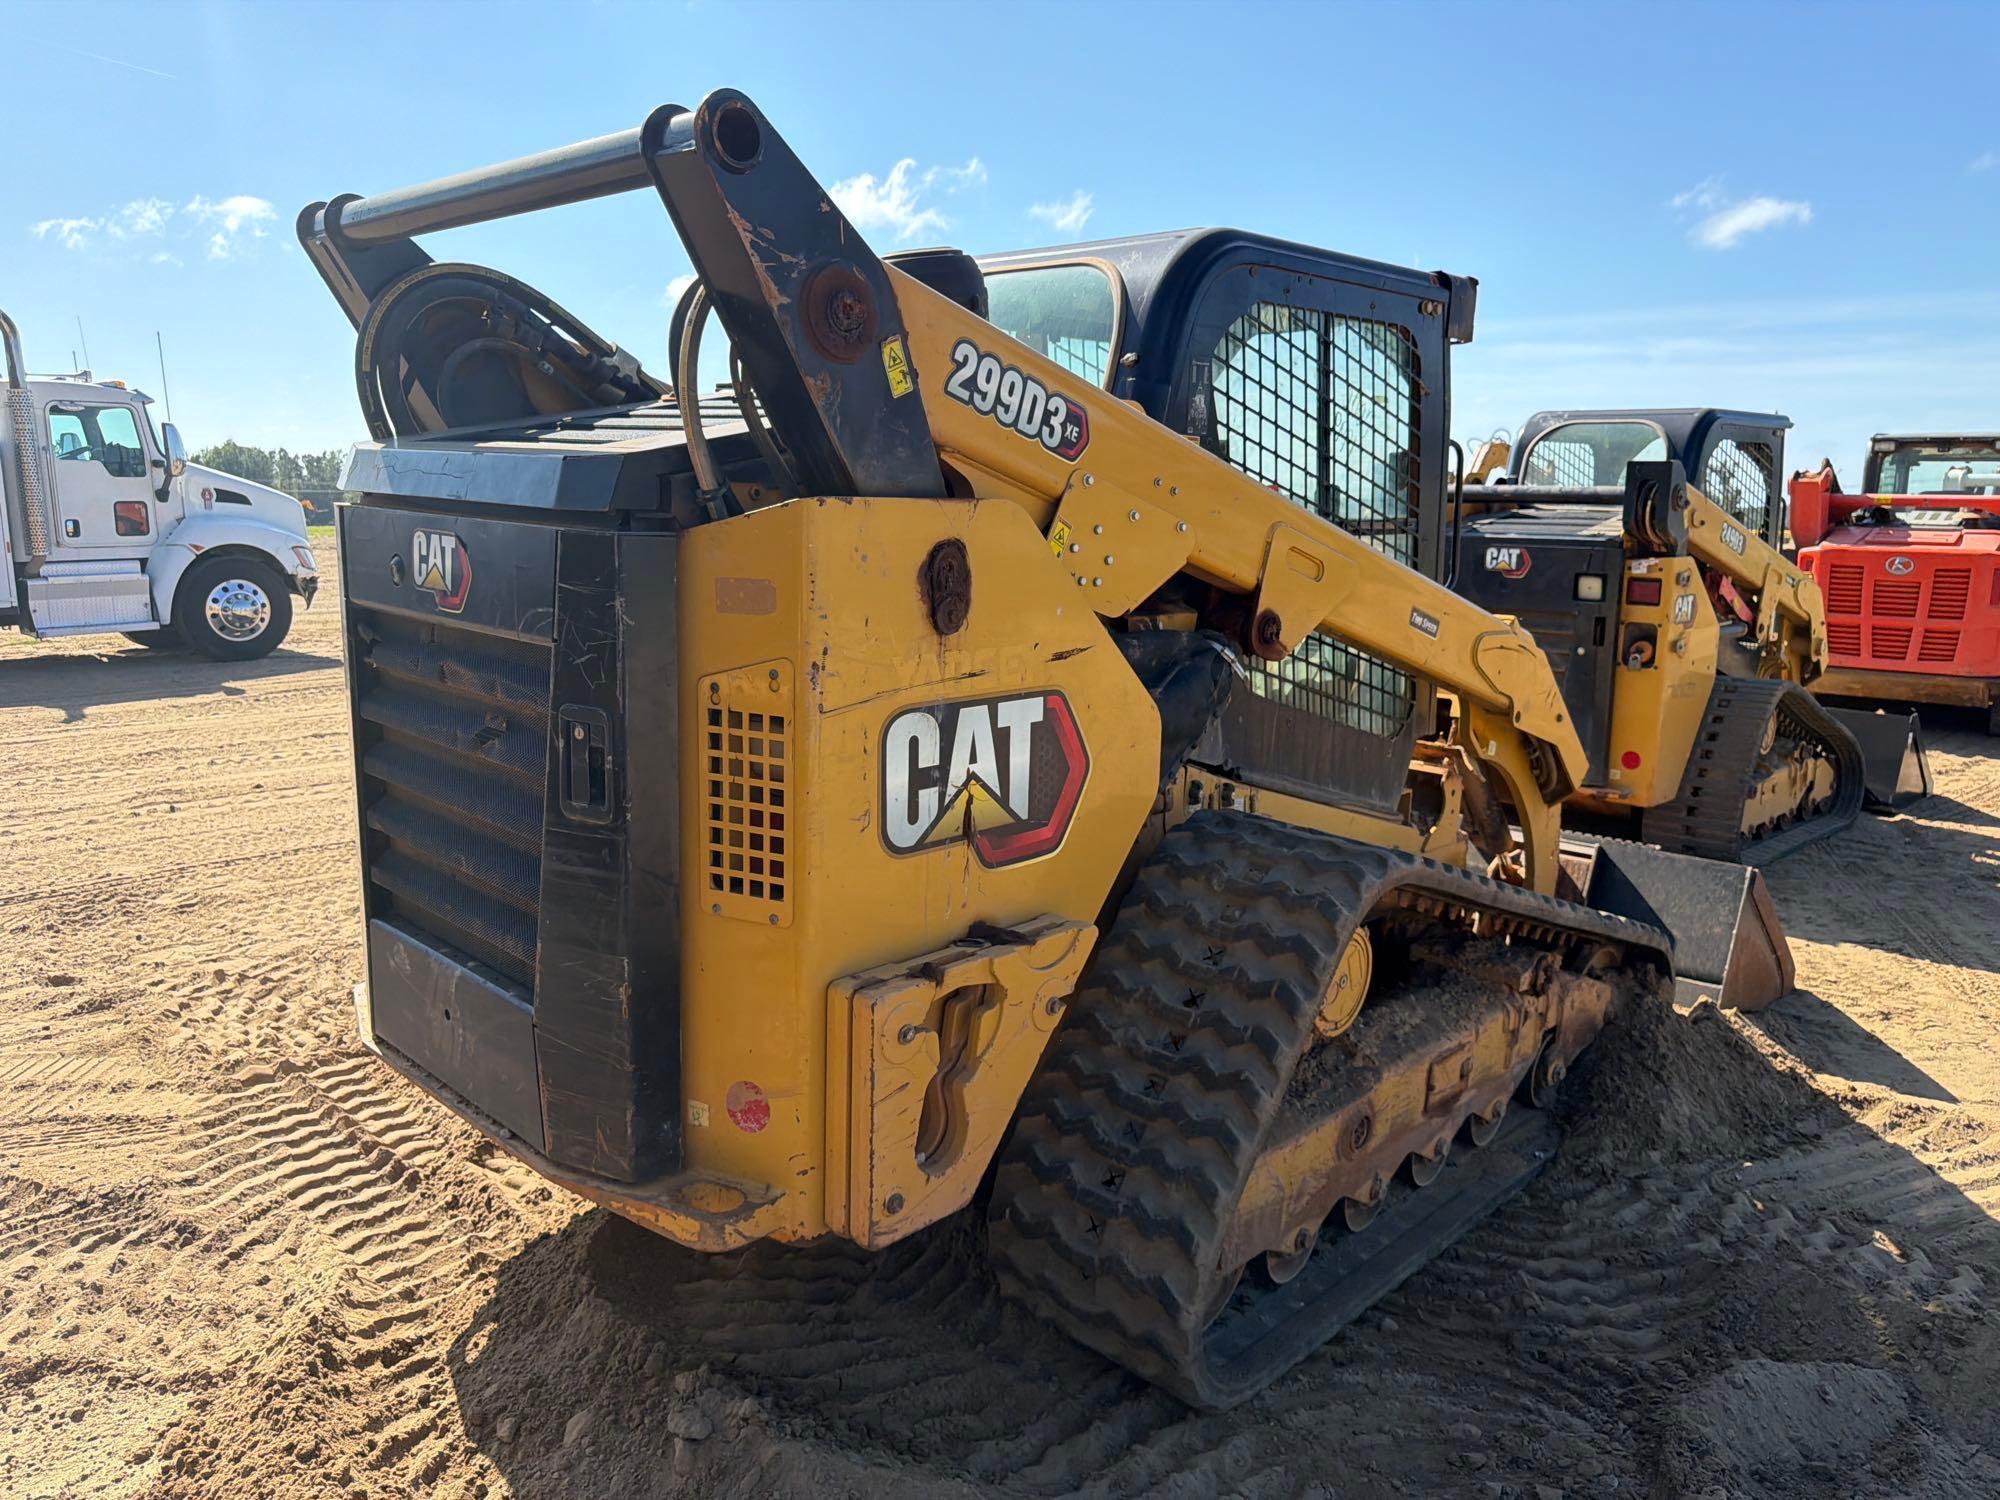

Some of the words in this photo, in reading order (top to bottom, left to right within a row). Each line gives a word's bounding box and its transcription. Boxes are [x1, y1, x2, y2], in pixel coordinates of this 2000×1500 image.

[946, 342, 1068, 448] 299D3
[1063, 422, 1080, 443] XE
[413, 530, 456, 592] CAT
[1485, 547, 1521, 570] CAT
[1675, 594, 1695, 624] CAT
[886, 696, 1044, 849] CAT
